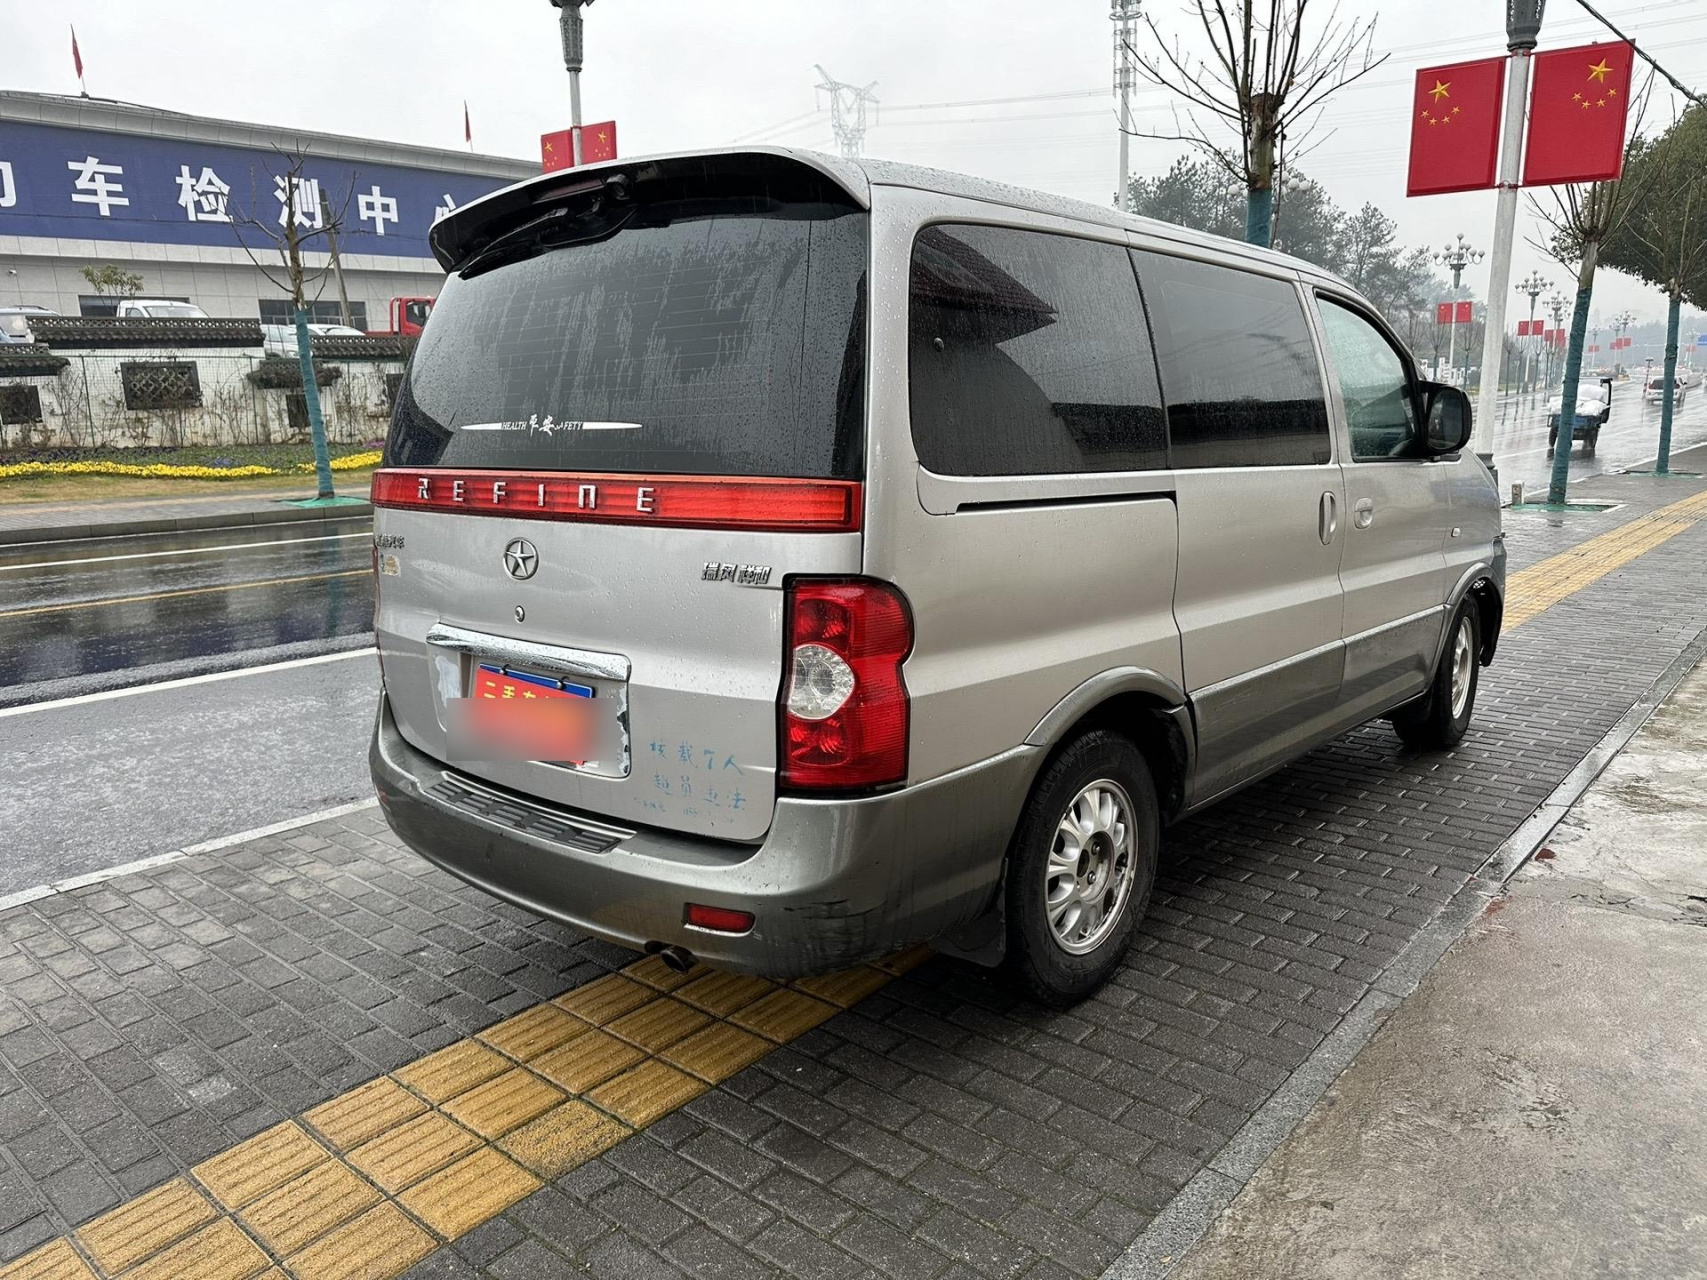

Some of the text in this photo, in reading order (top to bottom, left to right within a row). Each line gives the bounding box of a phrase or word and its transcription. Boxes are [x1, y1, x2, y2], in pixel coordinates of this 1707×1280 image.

[502, 421, 527, 430] HEALTH
[529, 414, 554, 437] 平安
[418, 478, 654, 512] REFINE
